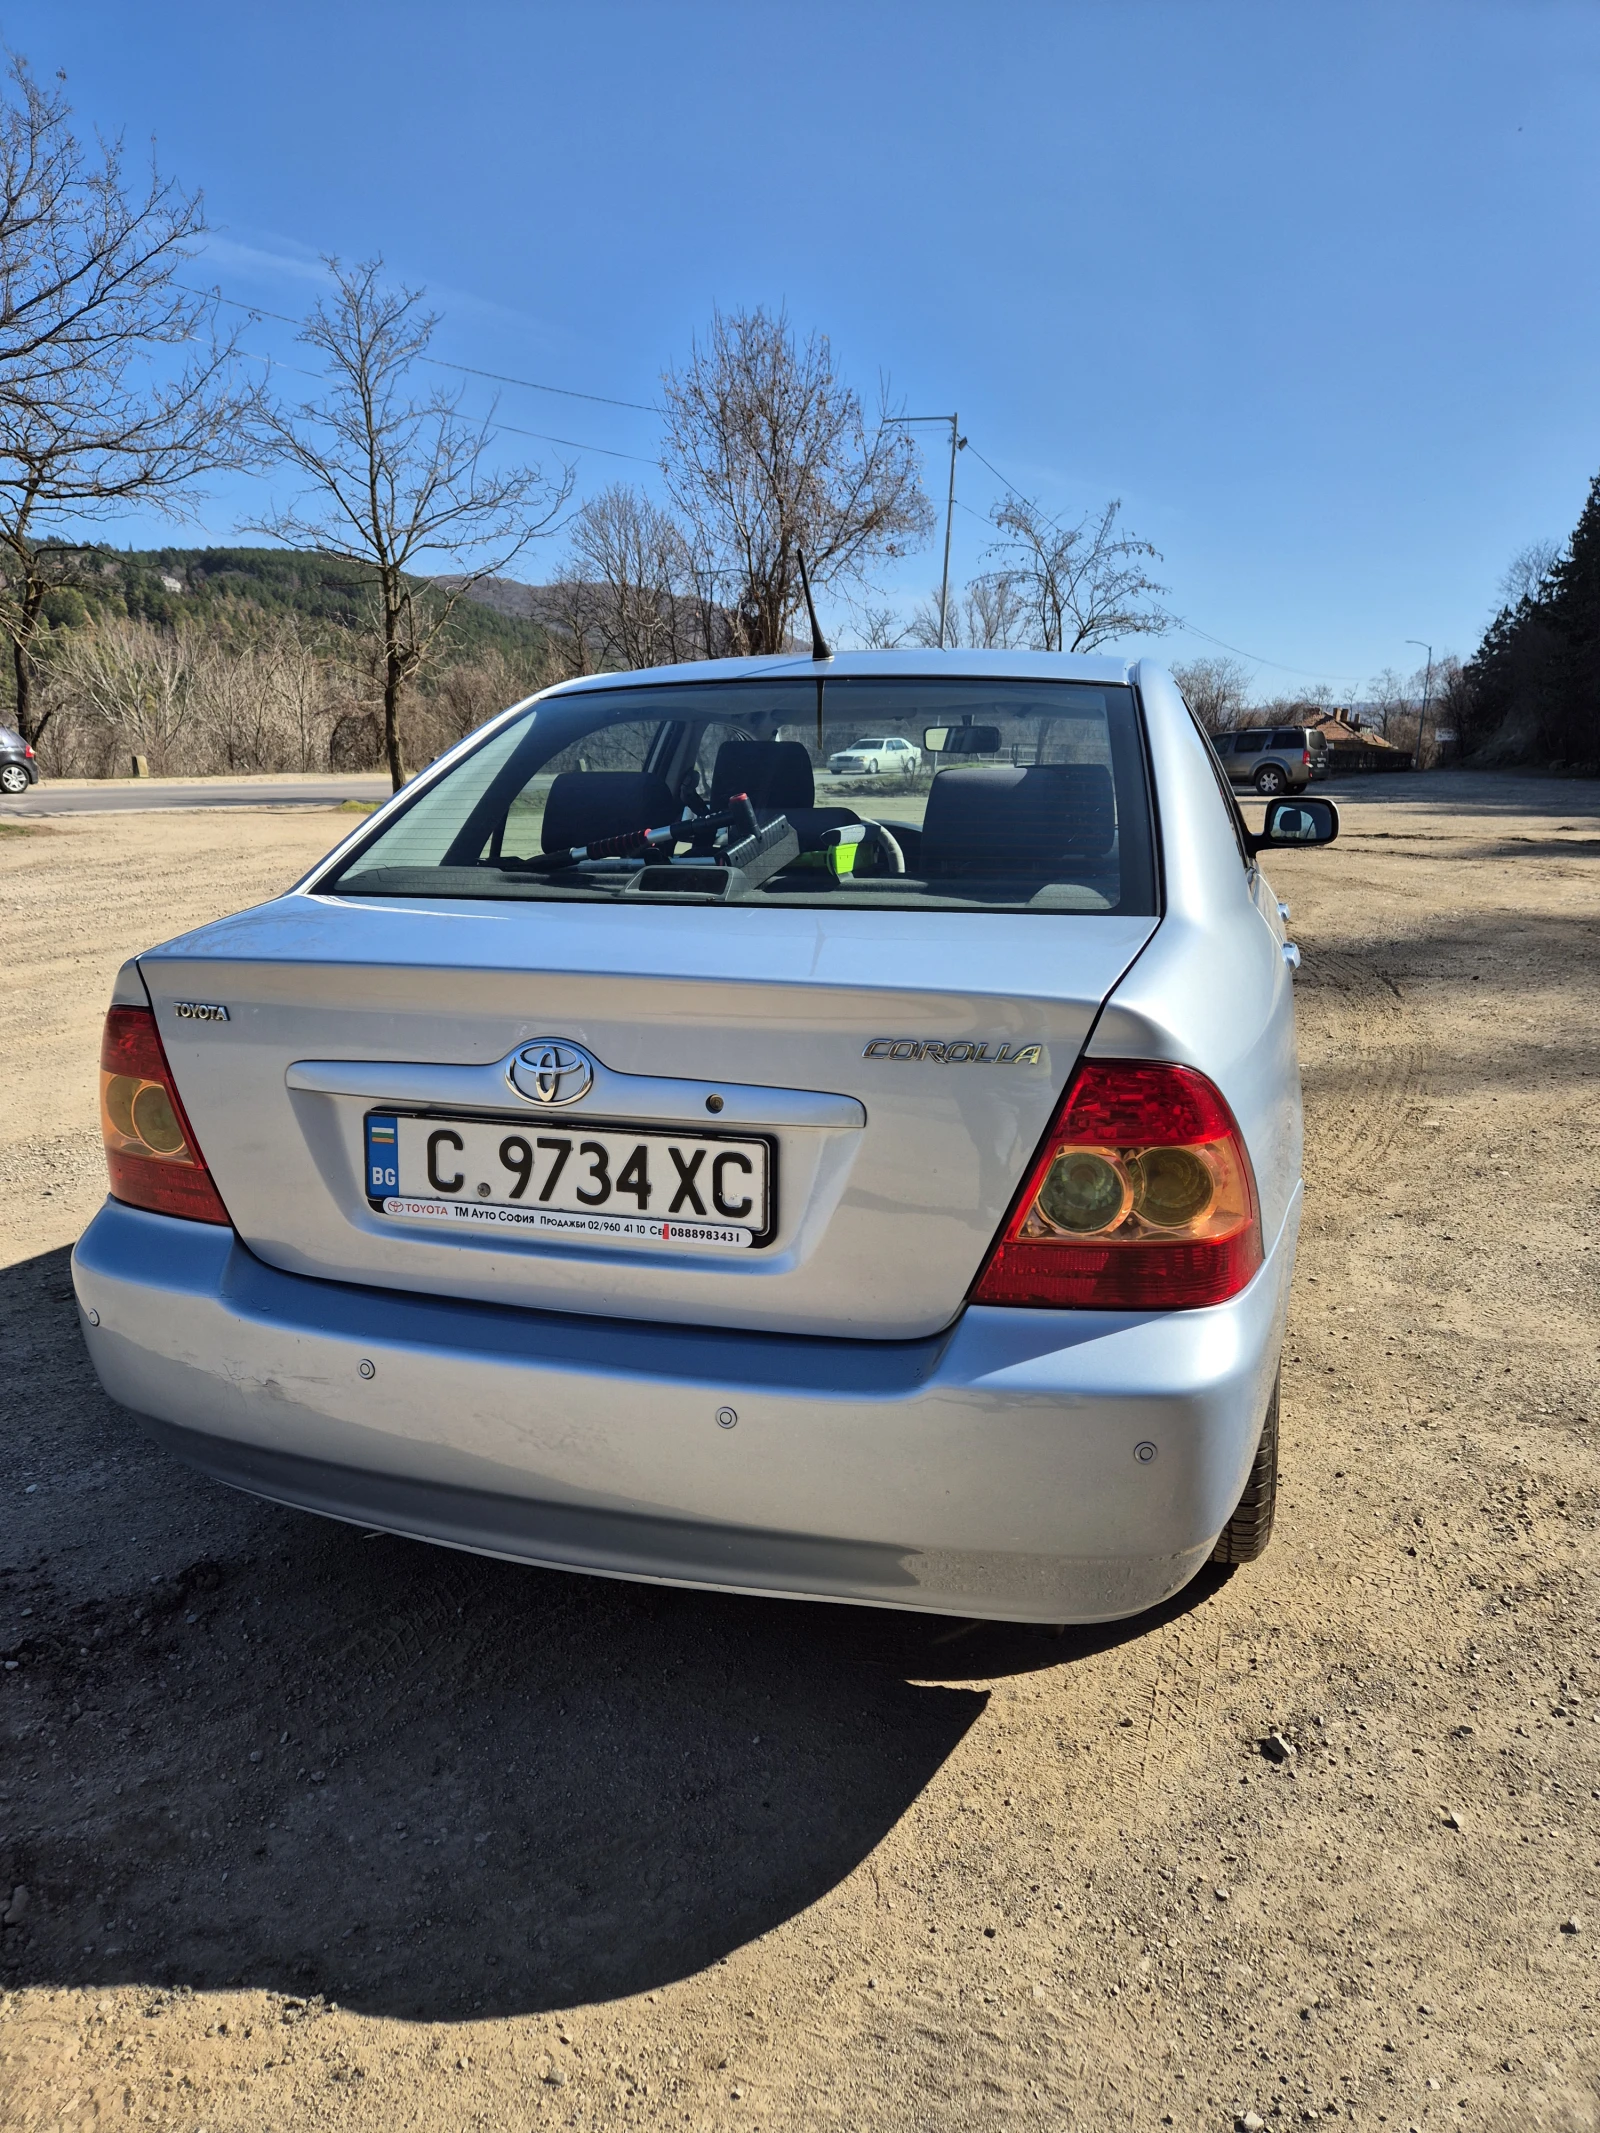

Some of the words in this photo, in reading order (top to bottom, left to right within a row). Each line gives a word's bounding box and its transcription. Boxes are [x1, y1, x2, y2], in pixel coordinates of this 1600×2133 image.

[173, 1002, 230, 1021] TOYOTA
[861, 1038, 1042, 1065] COROLLA
[372, 1167, 396, 1186] BG
[499, 1136, 652, 1210] 9734
[406, 1203, 448, 1216] TOYOTA
[588, 1220, 621, 1232] 02/960
[623, 1224, 633, 1233] 41
[636, 1224, 646, 1234] 10
[670, 1226, 740, 1243] 0888983431
